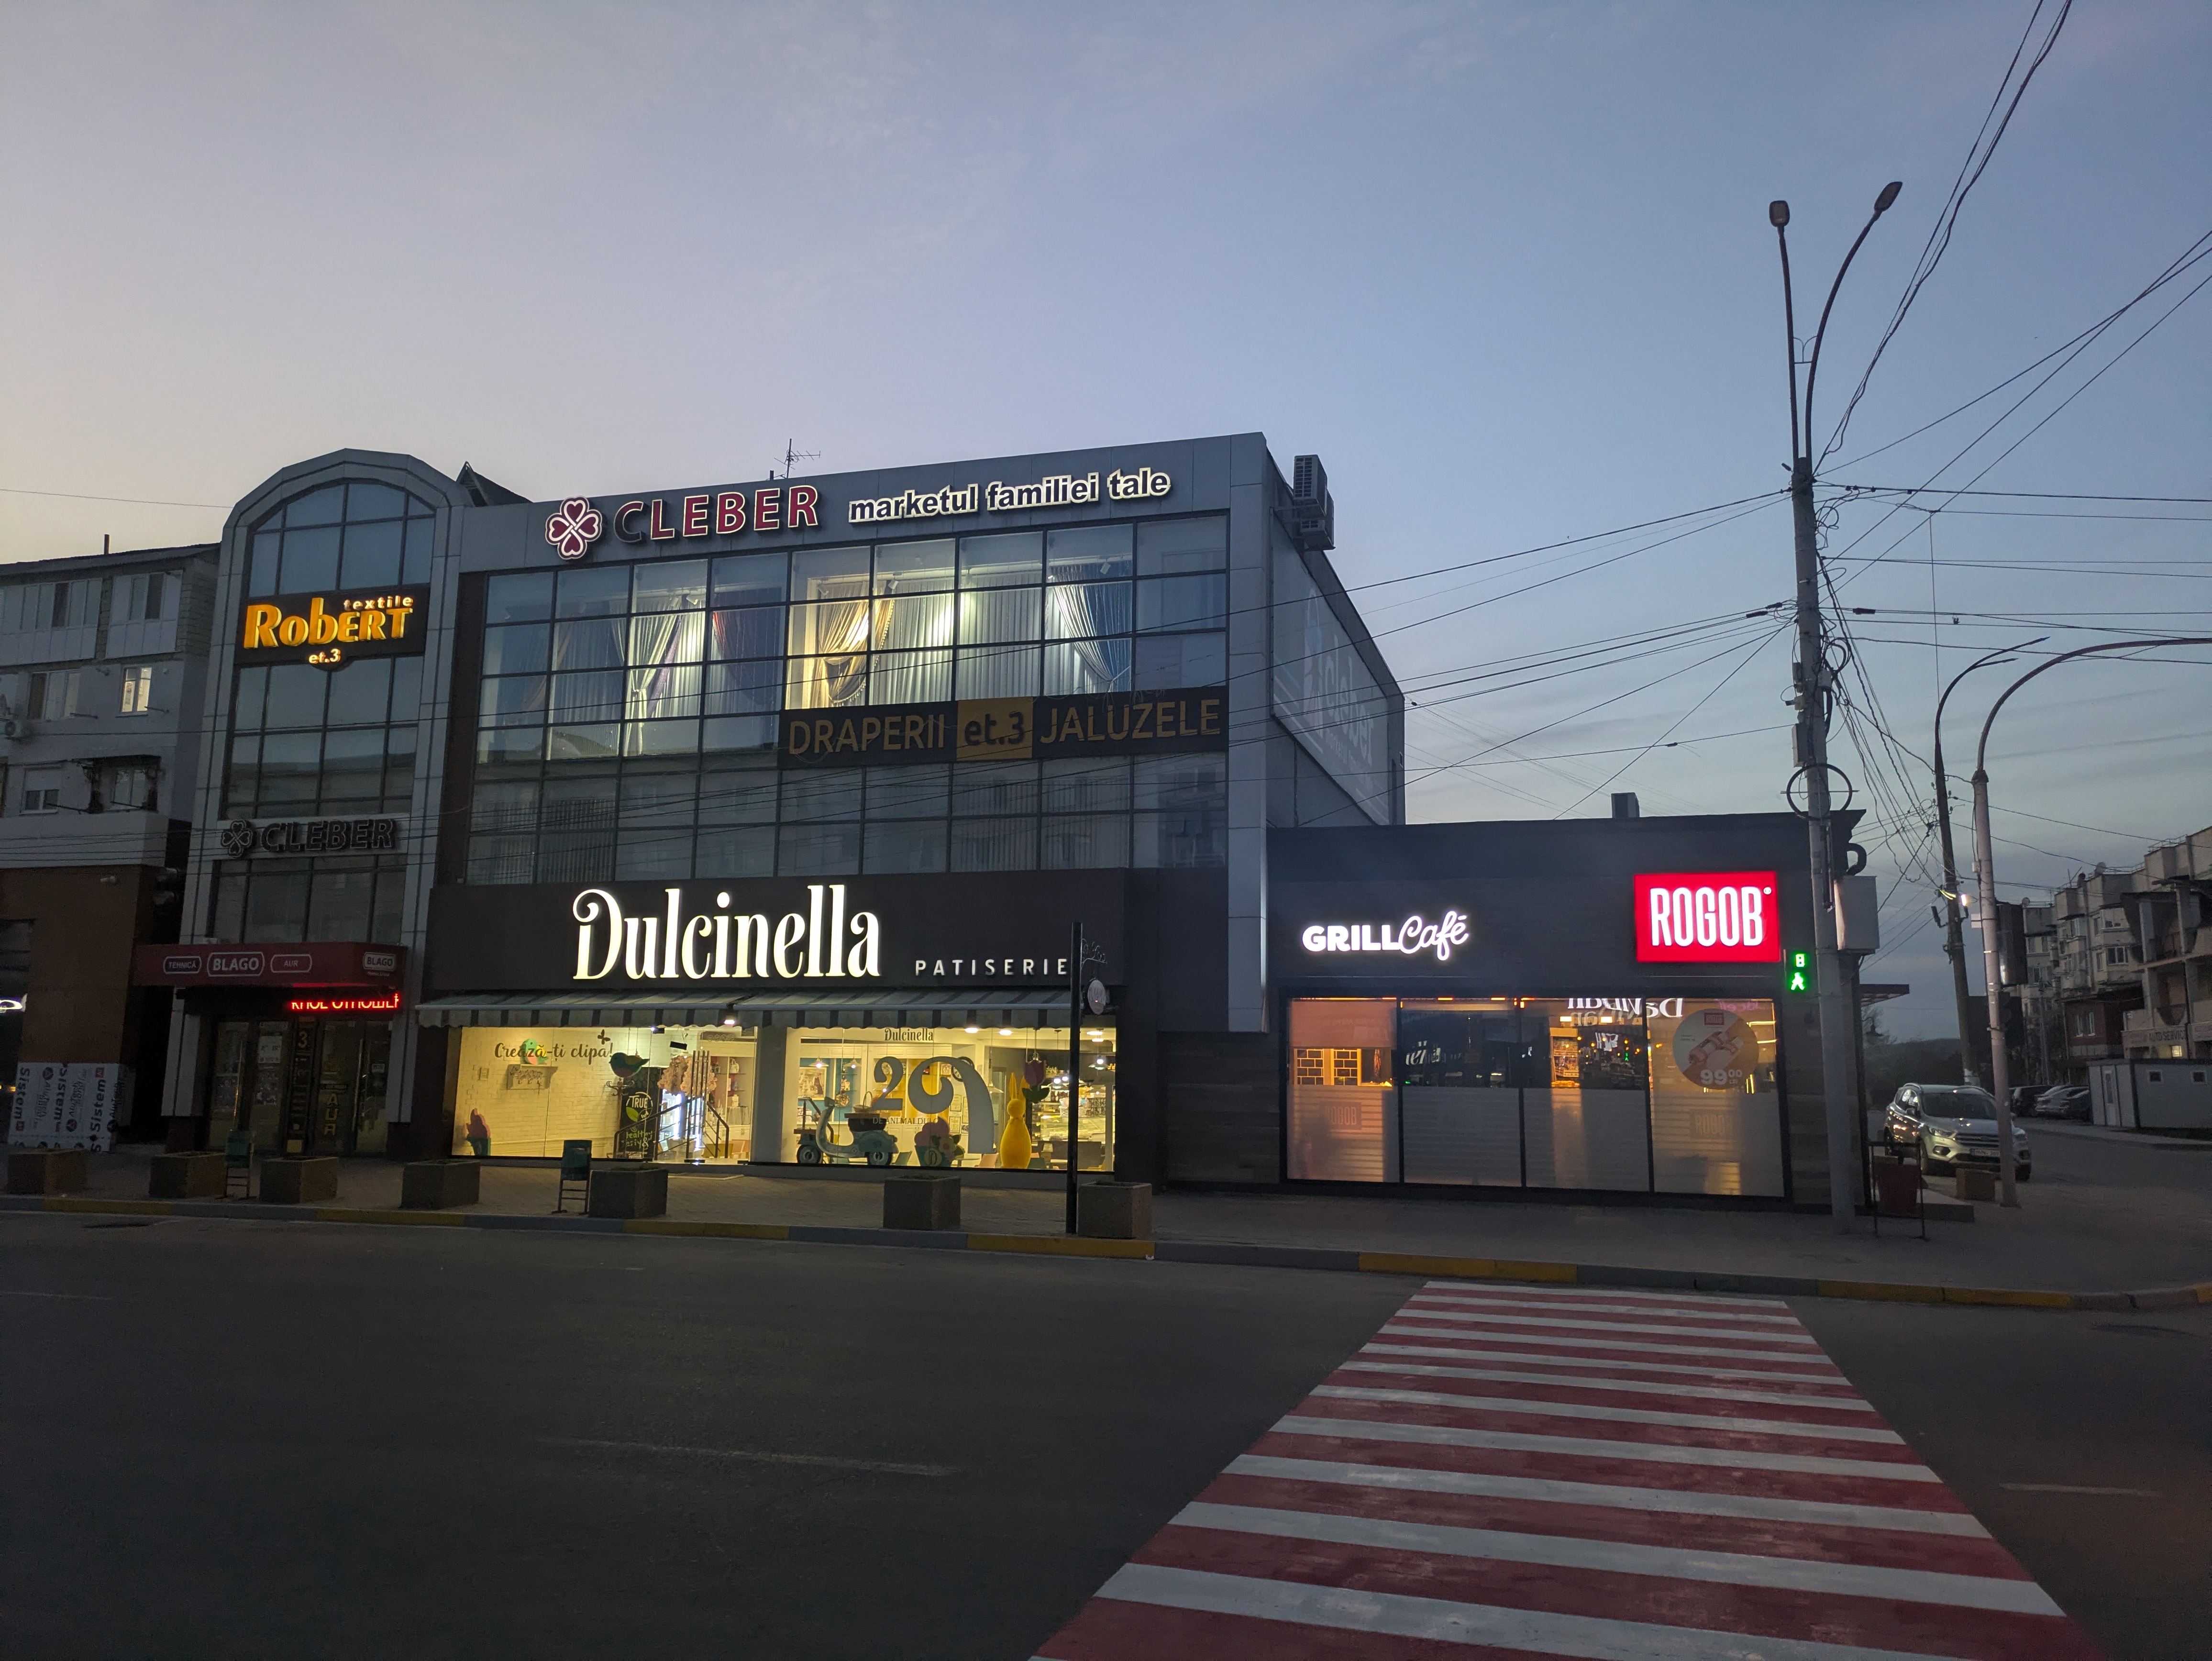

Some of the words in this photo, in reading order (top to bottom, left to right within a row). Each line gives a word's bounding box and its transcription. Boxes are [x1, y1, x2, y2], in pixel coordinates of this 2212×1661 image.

[849, 484, 979, 523] marketul
[985, 472, 1099, 511] familiei
[1107, 467, 1172, 500] tale
[613, 485, 818, 543] CLEBER
[343, 595, 413, 611] textile
[308, 649, 341, 664] et.3
[789, 714, 945, 755] DRAPERII
[964, 711, 1026, 746] et.3
[1040, 699, 1221, 744] JALUZELE
[261, 819, 397, 852] CLEBER
[1649, 886, 1764, 947] ROGOB
[572, 885, 882, 980] Dulcinella
[168, 960, 197, 969] TEHNICĂ
[212, 957, 259, 971] BLAGO
[367, 956, 393, 966] BLAGO
[915, 958, 1069, 976] PATISERIE
[298, 1030, 309, 1048] 3
[885, 1028, 934, 1041] Dulcinella
[2163, 1029, 2186, 1041] SERVIC
[571, 1042, 613, 1064] clipa!
[90, 1079, 107, 1132] Sistem
[629, 1095, 648, 1108] TRUE
